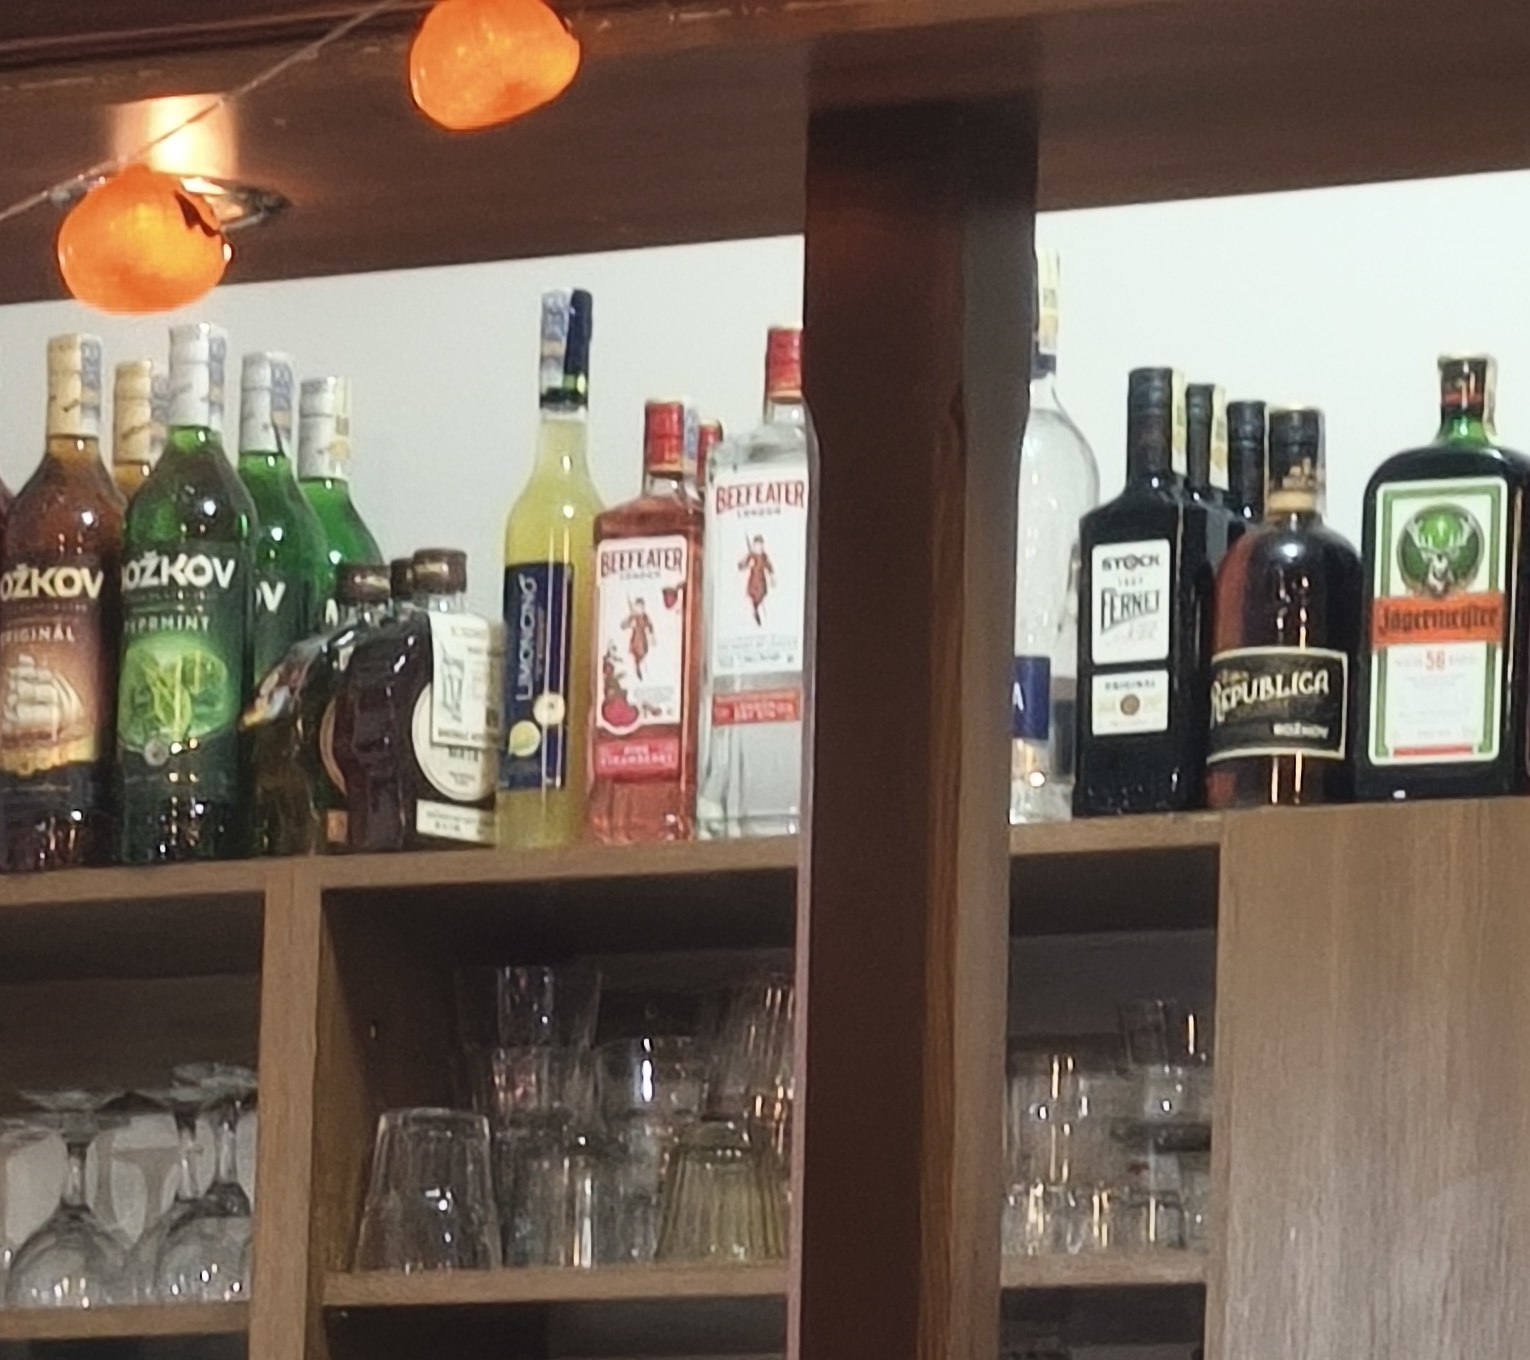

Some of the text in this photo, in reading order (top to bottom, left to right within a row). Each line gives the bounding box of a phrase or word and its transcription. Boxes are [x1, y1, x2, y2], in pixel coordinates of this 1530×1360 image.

[716, 480, 804, 515] BEEFEATER
[601, 547, 682, 577] BEEFEATER
[1102, 553, 1160, 571] STOCK
[0, 565, 104, 600] OŽKOV
[1101, 588, 1160, 634] FERNET
